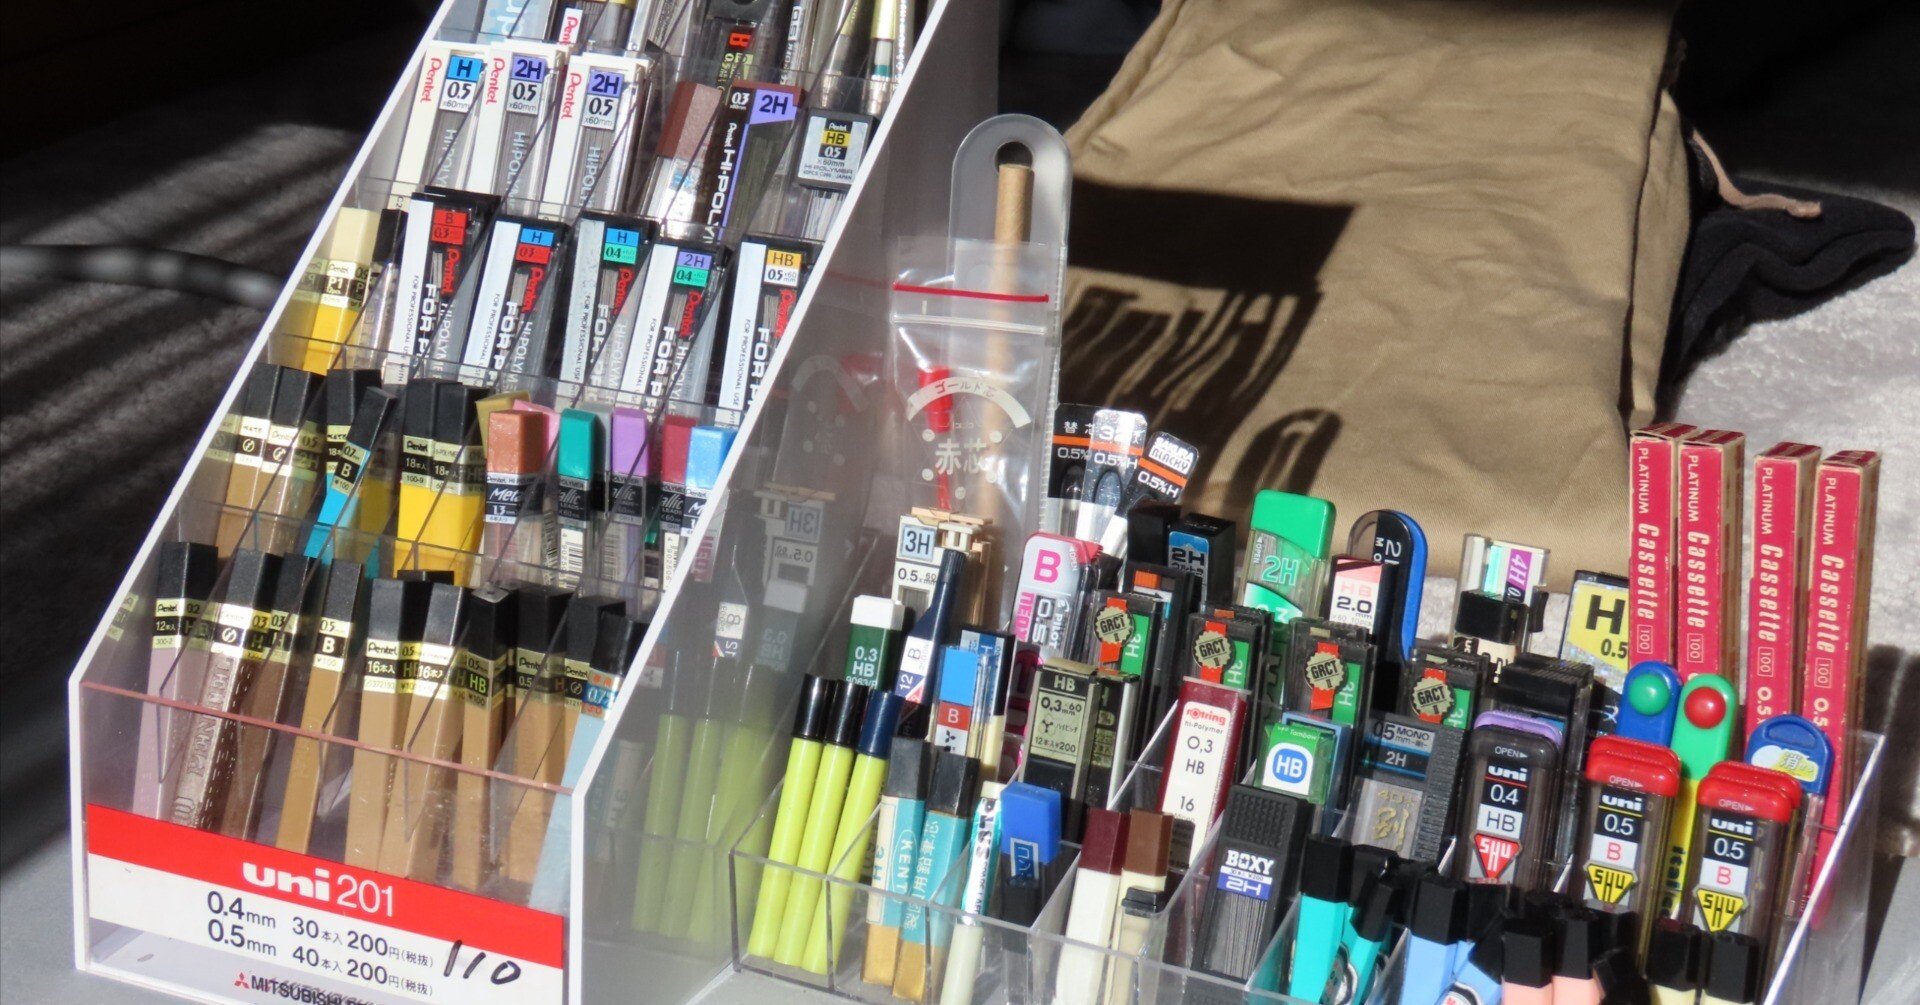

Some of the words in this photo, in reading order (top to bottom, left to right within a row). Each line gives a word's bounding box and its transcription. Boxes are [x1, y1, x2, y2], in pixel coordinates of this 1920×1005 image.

[456, 59, 472, 78] H
[514, 58, 542, 80] 2H
[420, 57, 441, 103] Pentel
[486, 57, 505, 104] Pentel
[591, 74, 619, 94] 2H
[446, 82, 471, 100] 0.5
[512, 82, 537, 101] 0.5
[561, 73, 582, 119] Pentel
[589, 97, 613, 116] 0.5
[759, 95, 787, 115] 2H
[826, 132, 845, 145] HB
[824, 146, 841, 158] 0.5
[445, 213, 454, 224] B
[532, 232, 543, 244] H
[617, 232, 628, 244] H
[684, 253, 705, 267] 2H
[772, 252, 793, 267] HB
[440, 247, 461, 295] Pentel
[768, 268, 783, 281] 0.5
[522, 267, 544, 314] Pentel
[420, 283, 439, 332] FOR
[679, 291, 702, 338] Pentel
[774, 289, 796, 338] Pentel
[496, 300, 518, 350] FOR
[652, 326, 674, 375] FOR
[751, 327, 769, 378] FOR
[406, 441, 428, 452] Pentel
[935, 438, 988, 475] 赤芯
[1154, 437, 1194, 463] SAKURA
[1150, 445, 1191, 475] BLACKY
[341, 465, 352, 478] B
[406, 474, 425, 485] 100-9
[1637, 447, 1649, 514] PLATINUM
[1687, 454, 1699, 522] PLATINUM
[1761, 466, 1773, 535] PLATINUM
[1822, 477, 1836, 546] PLATINUM
[905, 530, 931, 555] 3H
[1171, 547, 1205, 566] 2H
[1253, 542, 1263, 565] OPEN
[898, 567, 918, 582] 0.5
[1034, 548, 1062, 584] B
[1261, 555, 1299, 586] 2H
[1509, 554, 1528, 586] 4H
[1637, 523, 1659, 620] Cassette
[1687, 531, 1710, 628] Cassette
[1341, 582, 1371, 598] HB
[1759, 543, 1783, 643] Cassette
[157, 602, 179, 614] Pentel
[1336, 596, 1372, 614] 2.0
[1817, 553, 1844, 653] Cassette
[1032, 599, 1052, 643] 0.5
[1100, 614, 1127, 633] GRCT
[1585, 594, 1626, 634] H
[1049, 613, 1063, 649] PILOT
[1639, 627, 1651, 651] 100
[323, 637, 336, 654] B
[368, 641, 398, 655] Pentel
[854, 645, 879, 662] 0.3
[908, 647, 922, 659] B
[1125, 633, 1141, 658] 3H
[1199, 638, 1227, 658] GRCT
[1601, 639, 1629, 659] 0.5
[1689, 636, 1701, 659] 100
[367, 660, 395, 675] 16本入
[852, 661, 875, 678] HB
[1310, 660, 1339, 679] GRCT
[1760, 650, 1771, 673] 100
[565, 666, 589, 678] Pentel
[1228, 661, 1243, 684] 3H
[1816, 661, 1829, 685] 100
[470, 673, 487, 694] HB
[1053, 674, 1076, 692] HB
[1338, 681, 1354, 707] 3H
[1417, 685, 1446, 705] GRCT
[1757, 686, 1772, 716] 0.5
[1041, 697, 1062, 713] 0.3
[1813, 697, 1829, 727] 0.5
[948, 708, 959, 723] B
[1186, 708, 1226, 726] rotring
[1290, 728, 1318, 741] Tombow
[1396, 727, 1430, 740] MONO
[1385, 751, 1407, 768] 2H
[1494, 745, 1521, 758] OPEN
[1185, 758, 1205, 775] HB
[1275, 755, 1304, 778] HB
[1488, 765, 1528, 782] uni
[1609, 775, 1635, 788] OPEN
[1180, 795, 1195, 812] 16
[1490, 783, 1519, 805] 0.4
[1601, 794, 1643, 812] uni
[1718, 799, 1744, 812] OPEN
[1486, 810, 1516, 833] HB
[1603, 813, 1634, 836] 0.5
[1711, 817, 1754, 836] uni
[1606, 843, 1621, 861] B
[1713, 838, 1744, 860] 0.5
[896, 838, 915, 892] KENT
[1225, 849, 1275, 875] BOXY
[1226, 876, 1261, 896] 2H
[1716, 867, 1732, 885] B
[242, 862, 331, 902] uni
[336, 874, 394, 918] 201
[207, 890, 277, 929] 0.4mm
[207, 919, 277, 957] 0.5mm
[443, 939, 522, 986] 110
